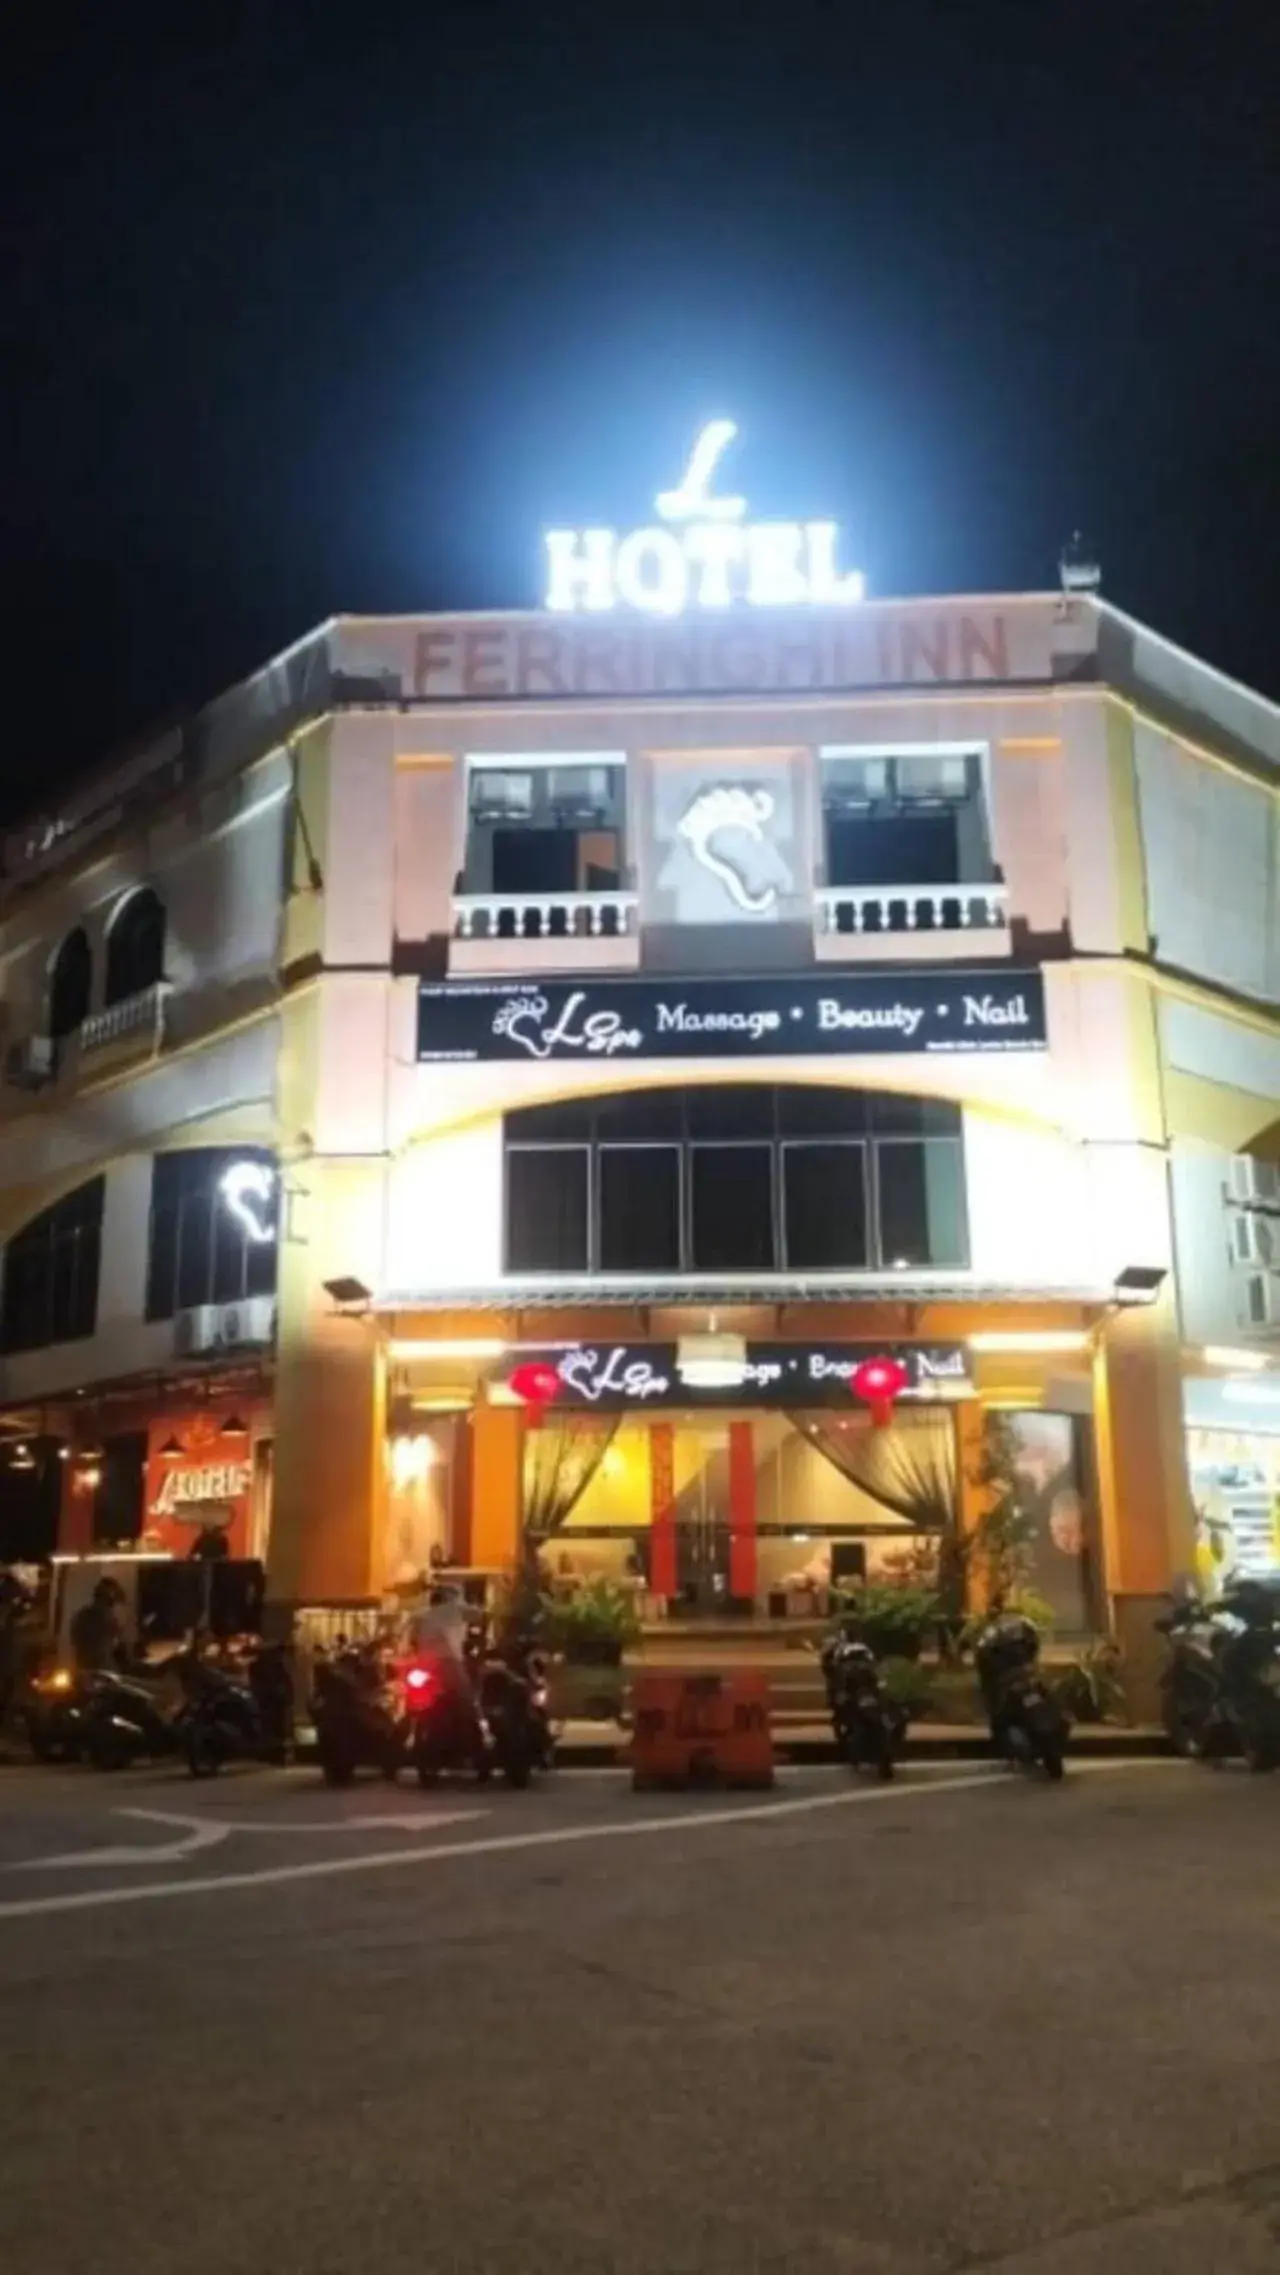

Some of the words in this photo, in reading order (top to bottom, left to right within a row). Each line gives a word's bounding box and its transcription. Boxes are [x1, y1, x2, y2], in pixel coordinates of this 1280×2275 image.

[654, 418, 747, 520] L
[544, 521, 865, 614] HOTEL
[413, 623, 847, 695] FERRINGHI
[877, 616, 1010, 680] INN
[655, 1002, 781, 1041] Massage
[818, 998, 923, 1036] Beauty
[963, 994, 1029, 1026] Nail
